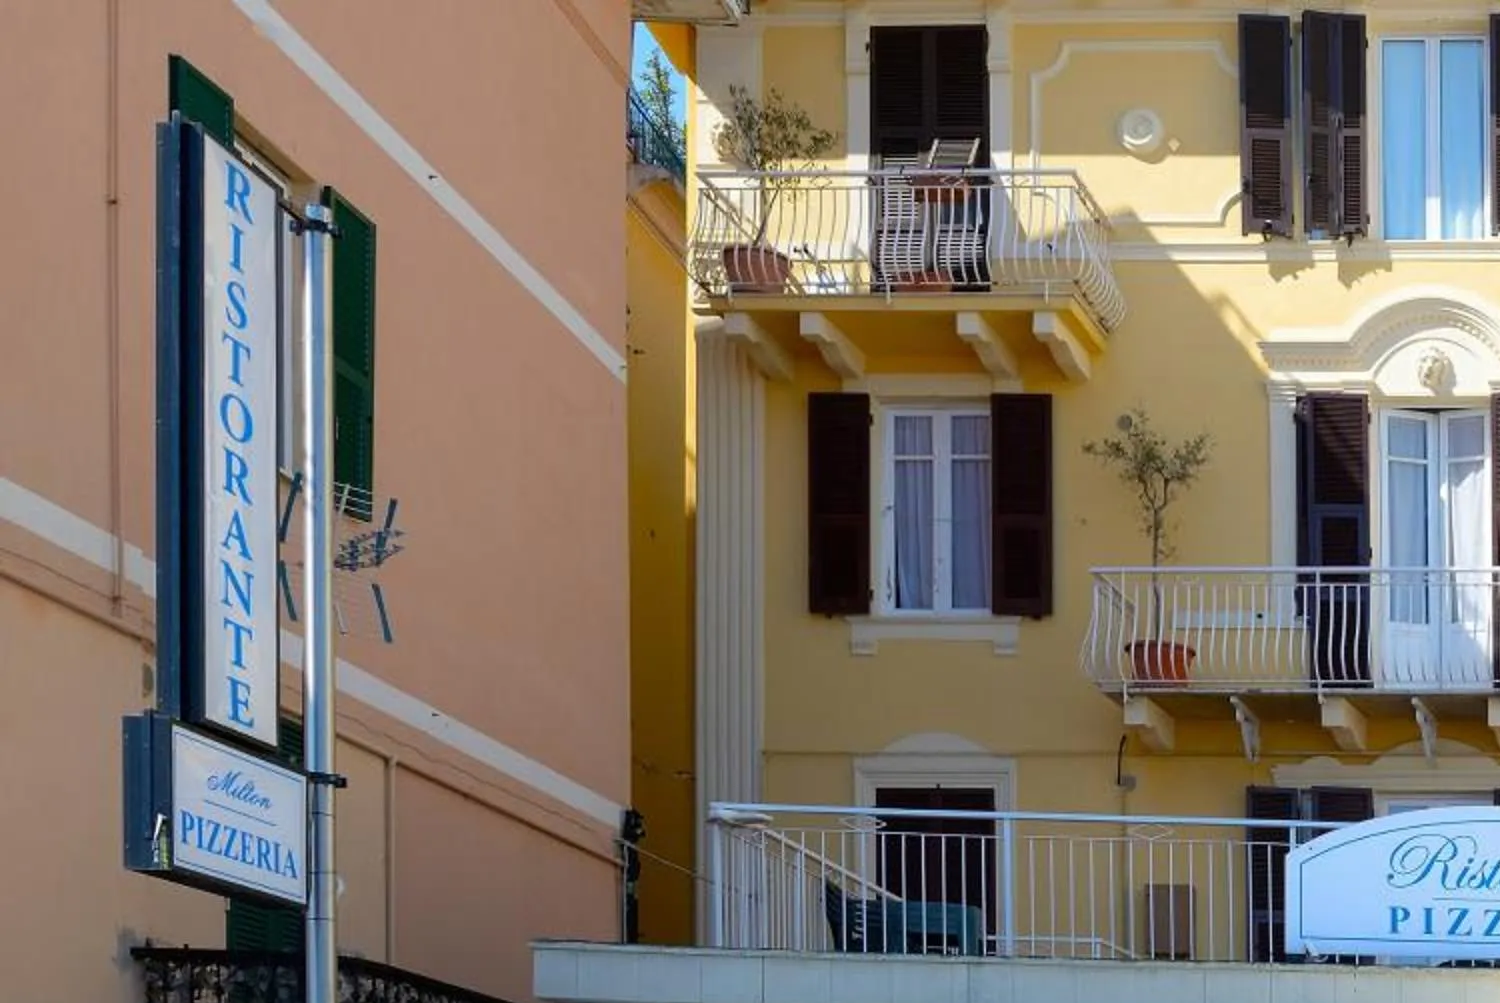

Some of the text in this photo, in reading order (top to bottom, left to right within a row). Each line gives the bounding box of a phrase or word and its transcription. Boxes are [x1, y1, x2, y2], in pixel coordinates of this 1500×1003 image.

[220, 161, 254, 729] RISTORANTE
[208, 770, 272, 809] Milton
[181, 811, 298, 879] PIZZERIA
